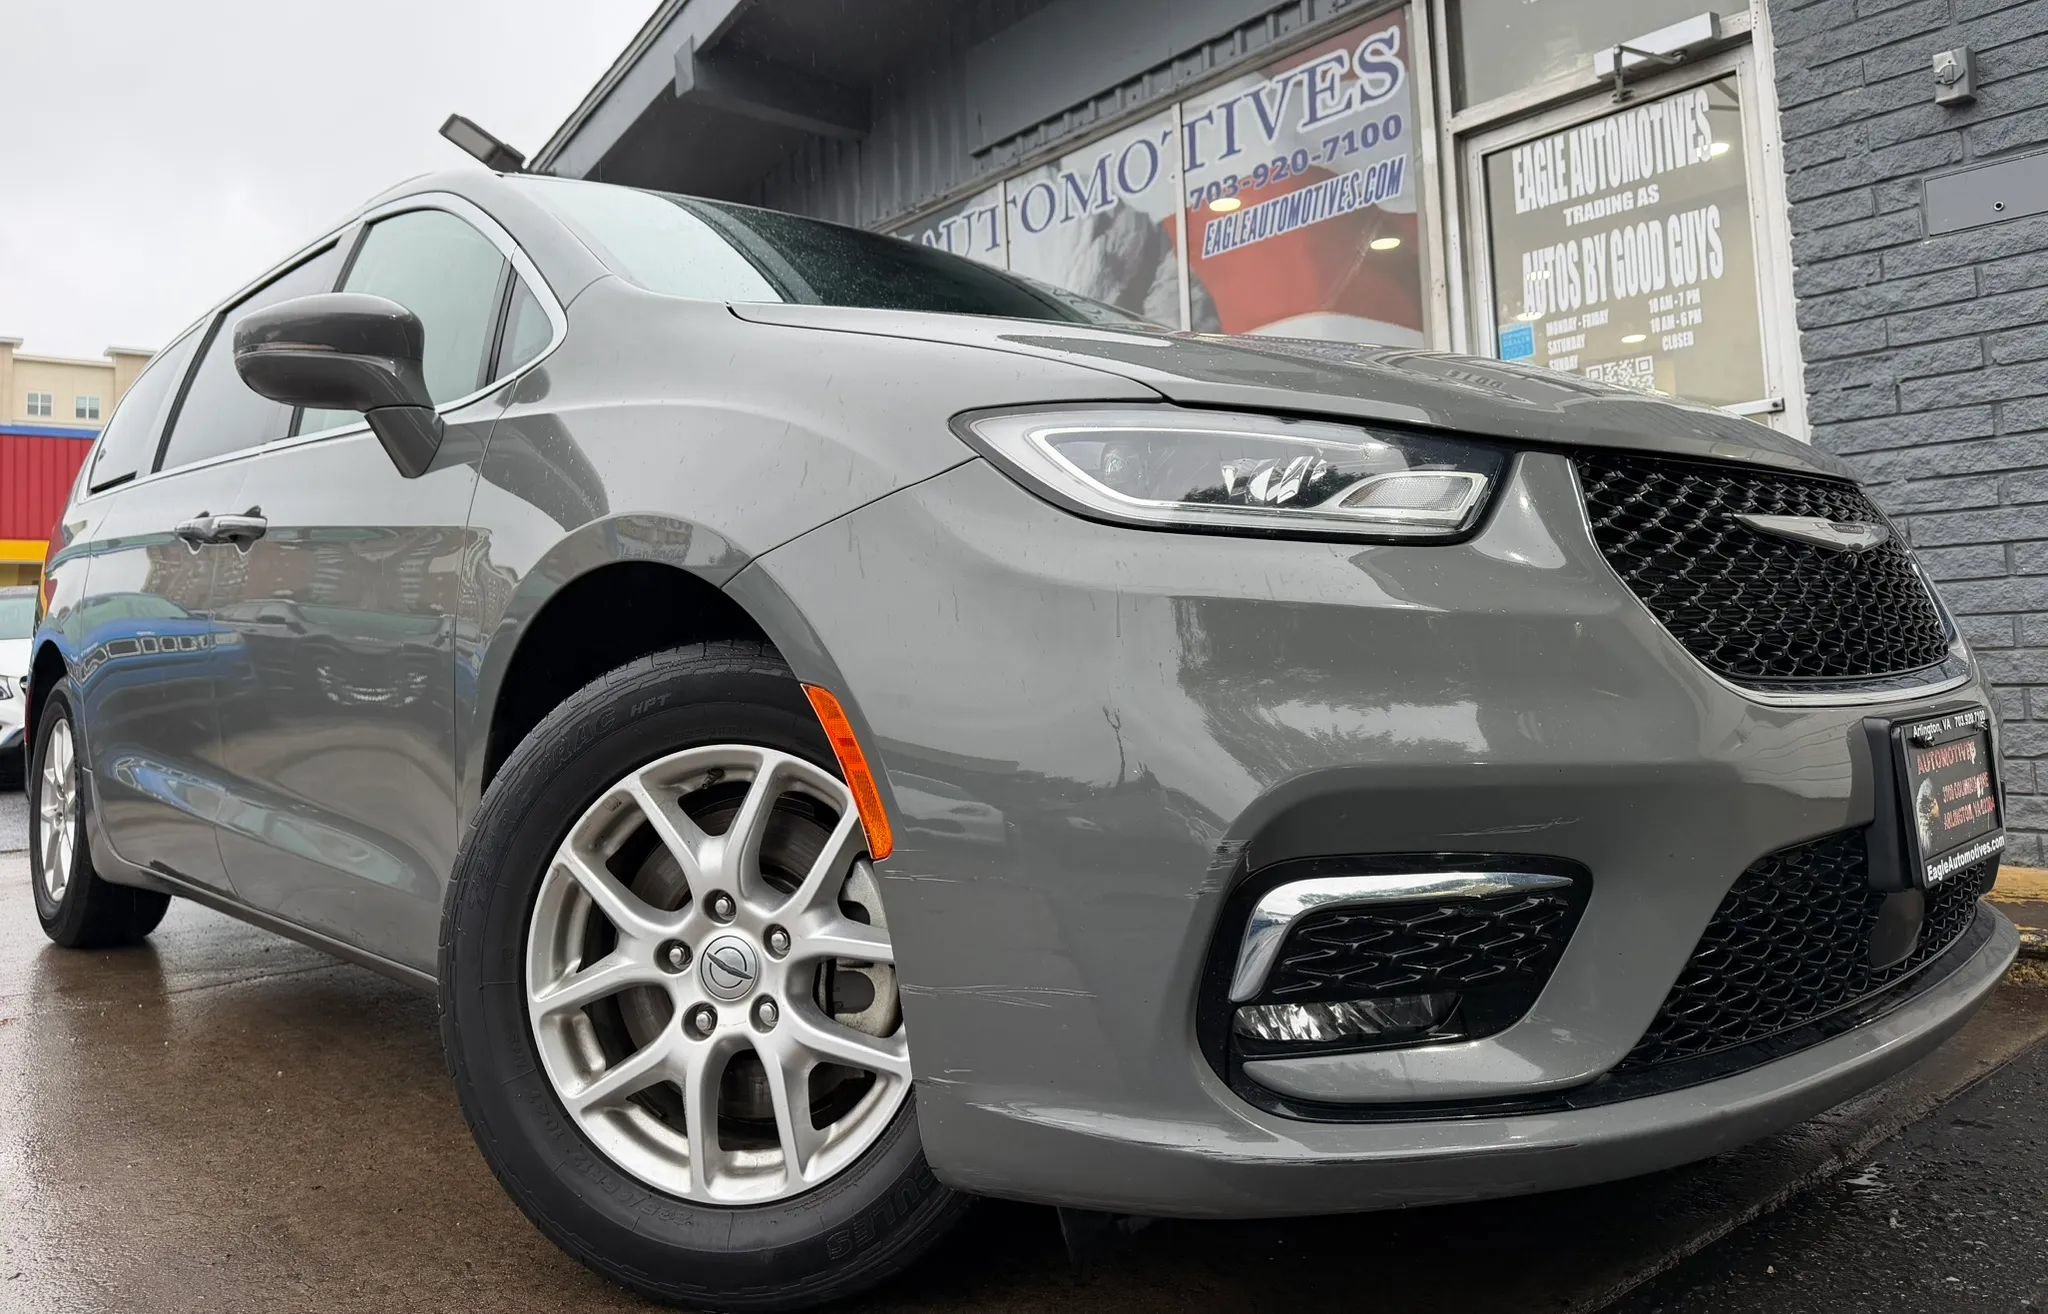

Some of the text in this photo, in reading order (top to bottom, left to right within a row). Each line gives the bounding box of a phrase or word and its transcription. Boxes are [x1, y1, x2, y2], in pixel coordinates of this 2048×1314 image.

[1190, 114, 1402, 209] 703-920-7100
[1512, 90, 1713, 214] EAGLE AUTOMOTIVES
[1203, 156, 1406, 259] EAGLEAUTOMOTIVES.COM
[1563, 184, 1660, 227] TRADING AS
[1523, 204, 1724, 317] AUTOS BY GOOD GUYS
[1662, 330, 1694, 352] CLOSED
[631, 692, 672, 718] HPT
[1912, 721, 1943, 739] Arlington,
[1942, 720, 1952, 730] VA
[1926, 835, 2005, 882] EagleAutomotives.com
